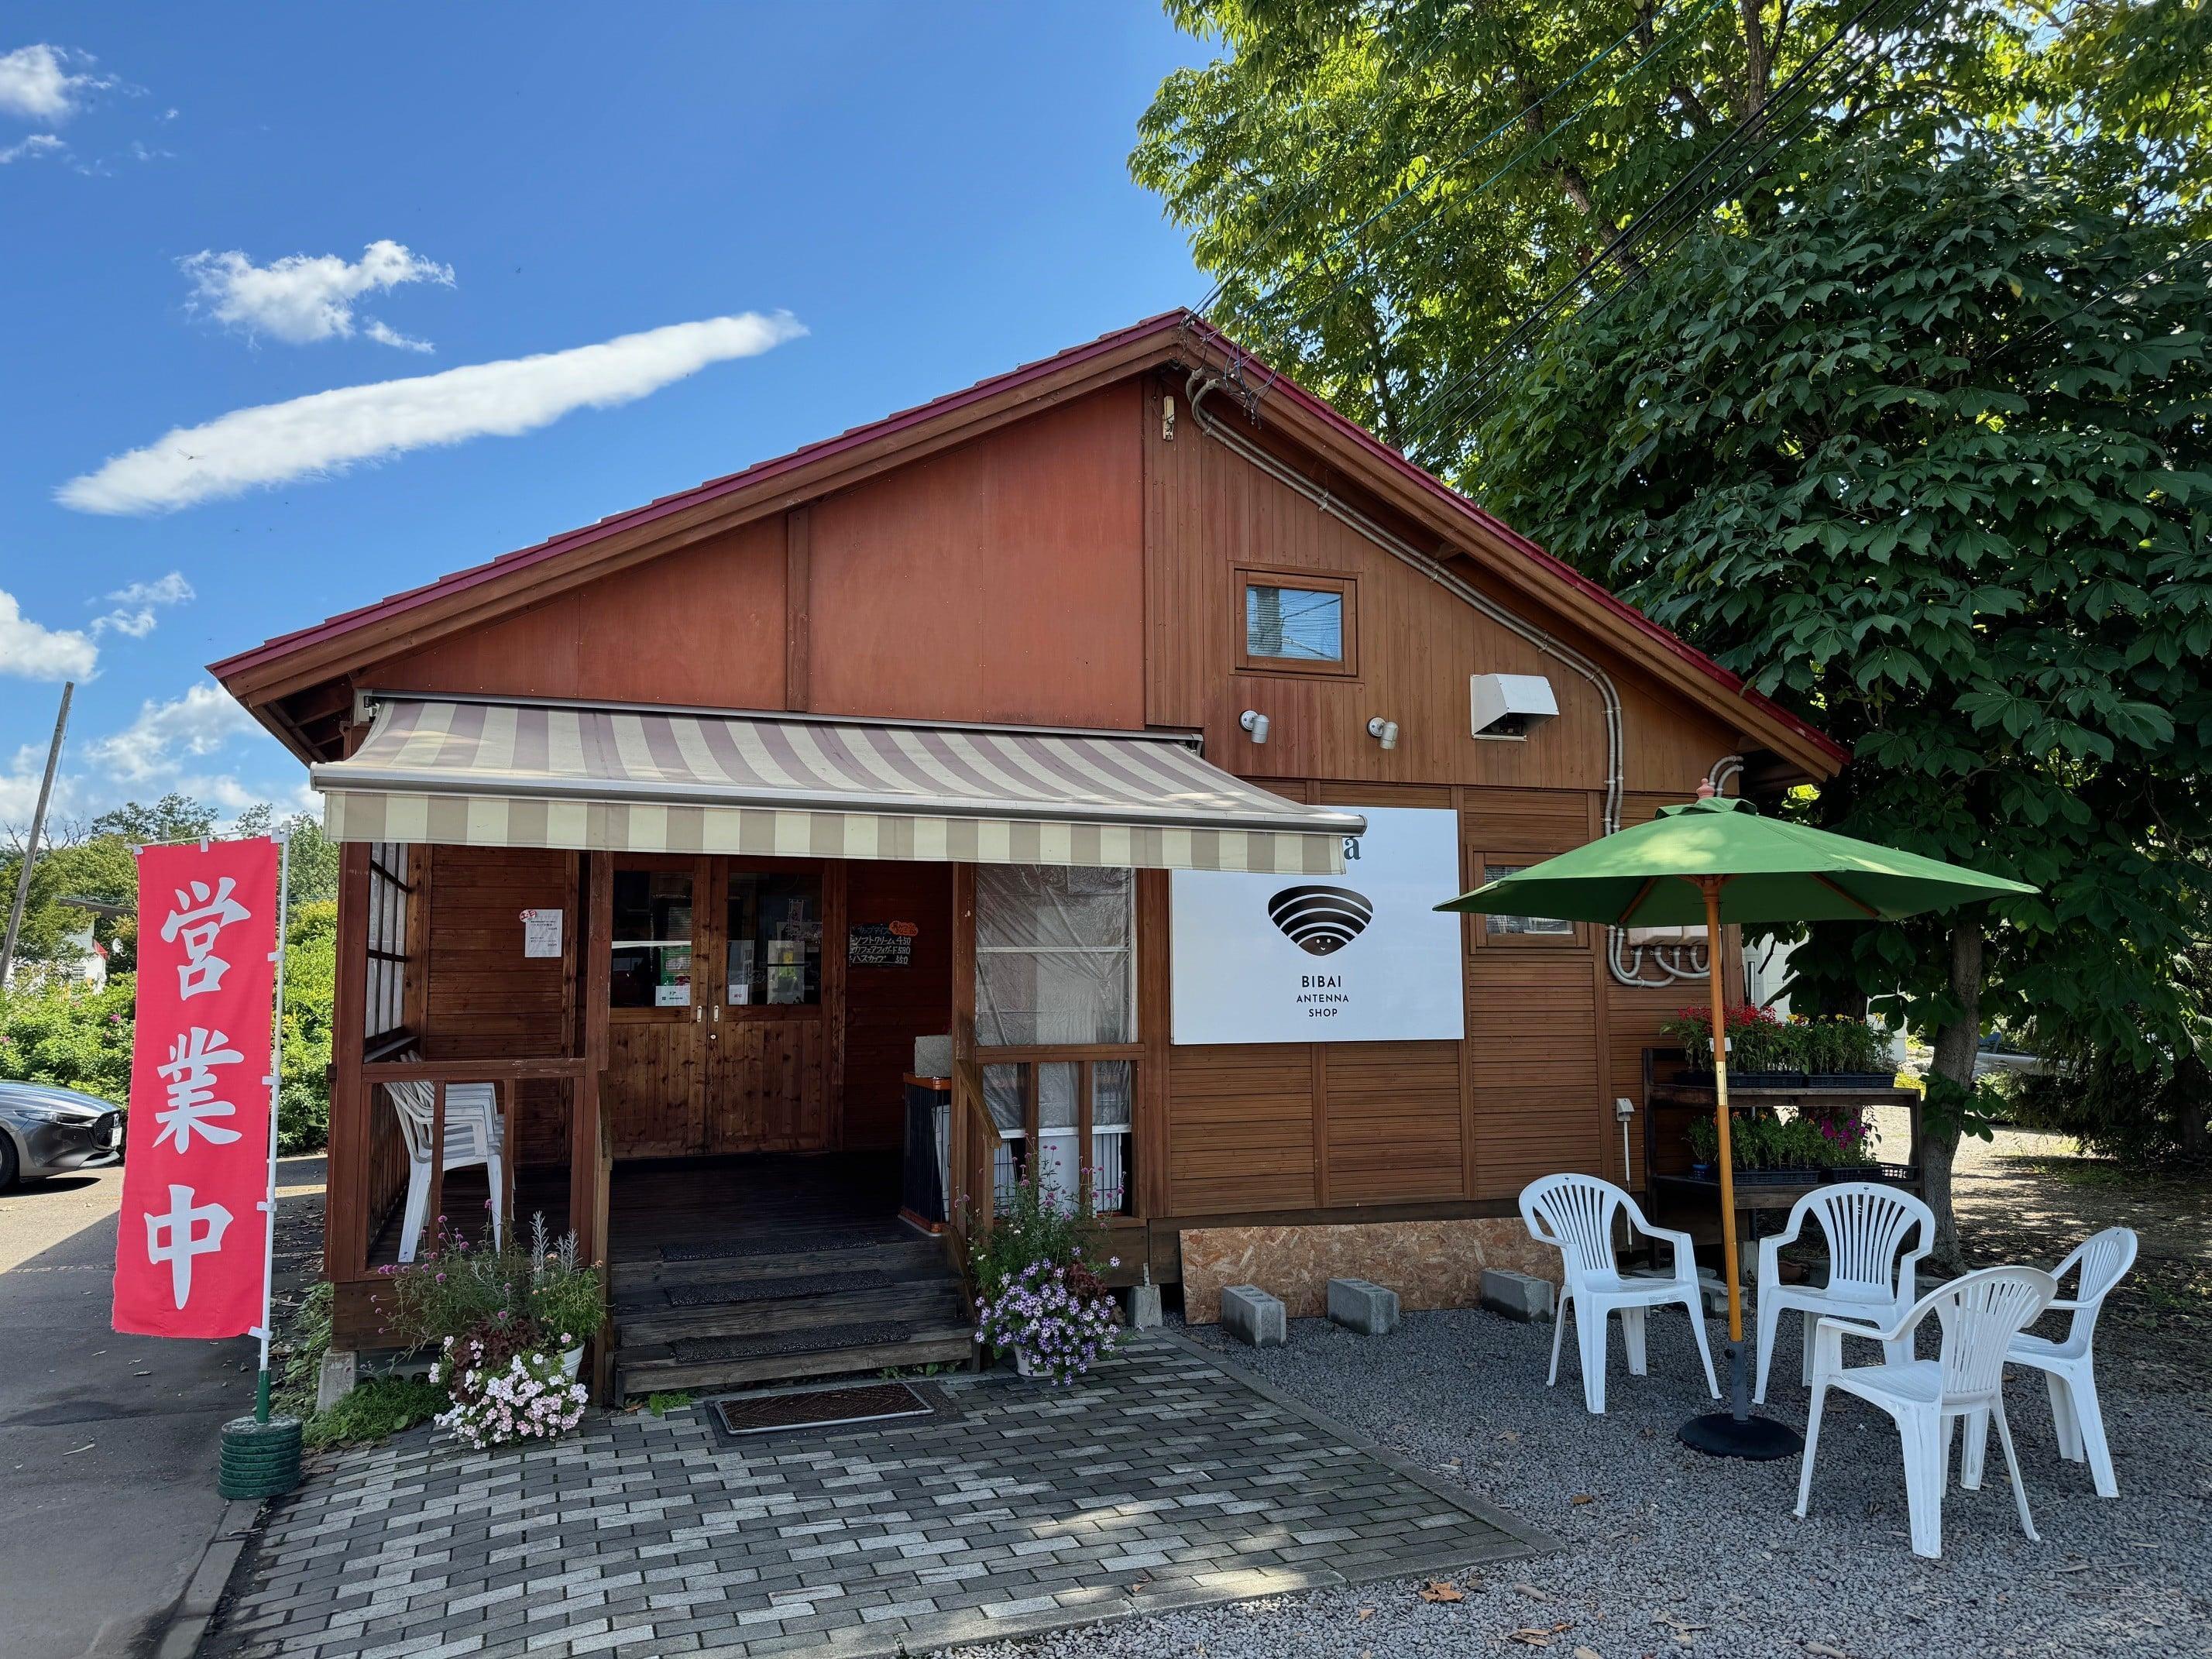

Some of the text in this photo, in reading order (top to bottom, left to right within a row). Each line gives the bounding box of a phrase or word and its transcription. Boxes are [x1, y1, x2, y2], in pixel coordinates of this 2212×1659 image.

[1302, 975, 1341, 988] BIBAI
[1296, 994, 1349, 1004] ANTENNA
[1309, 1008, 1338, 1018] SHOP
[143, 877, 252, 1310] 営業中
